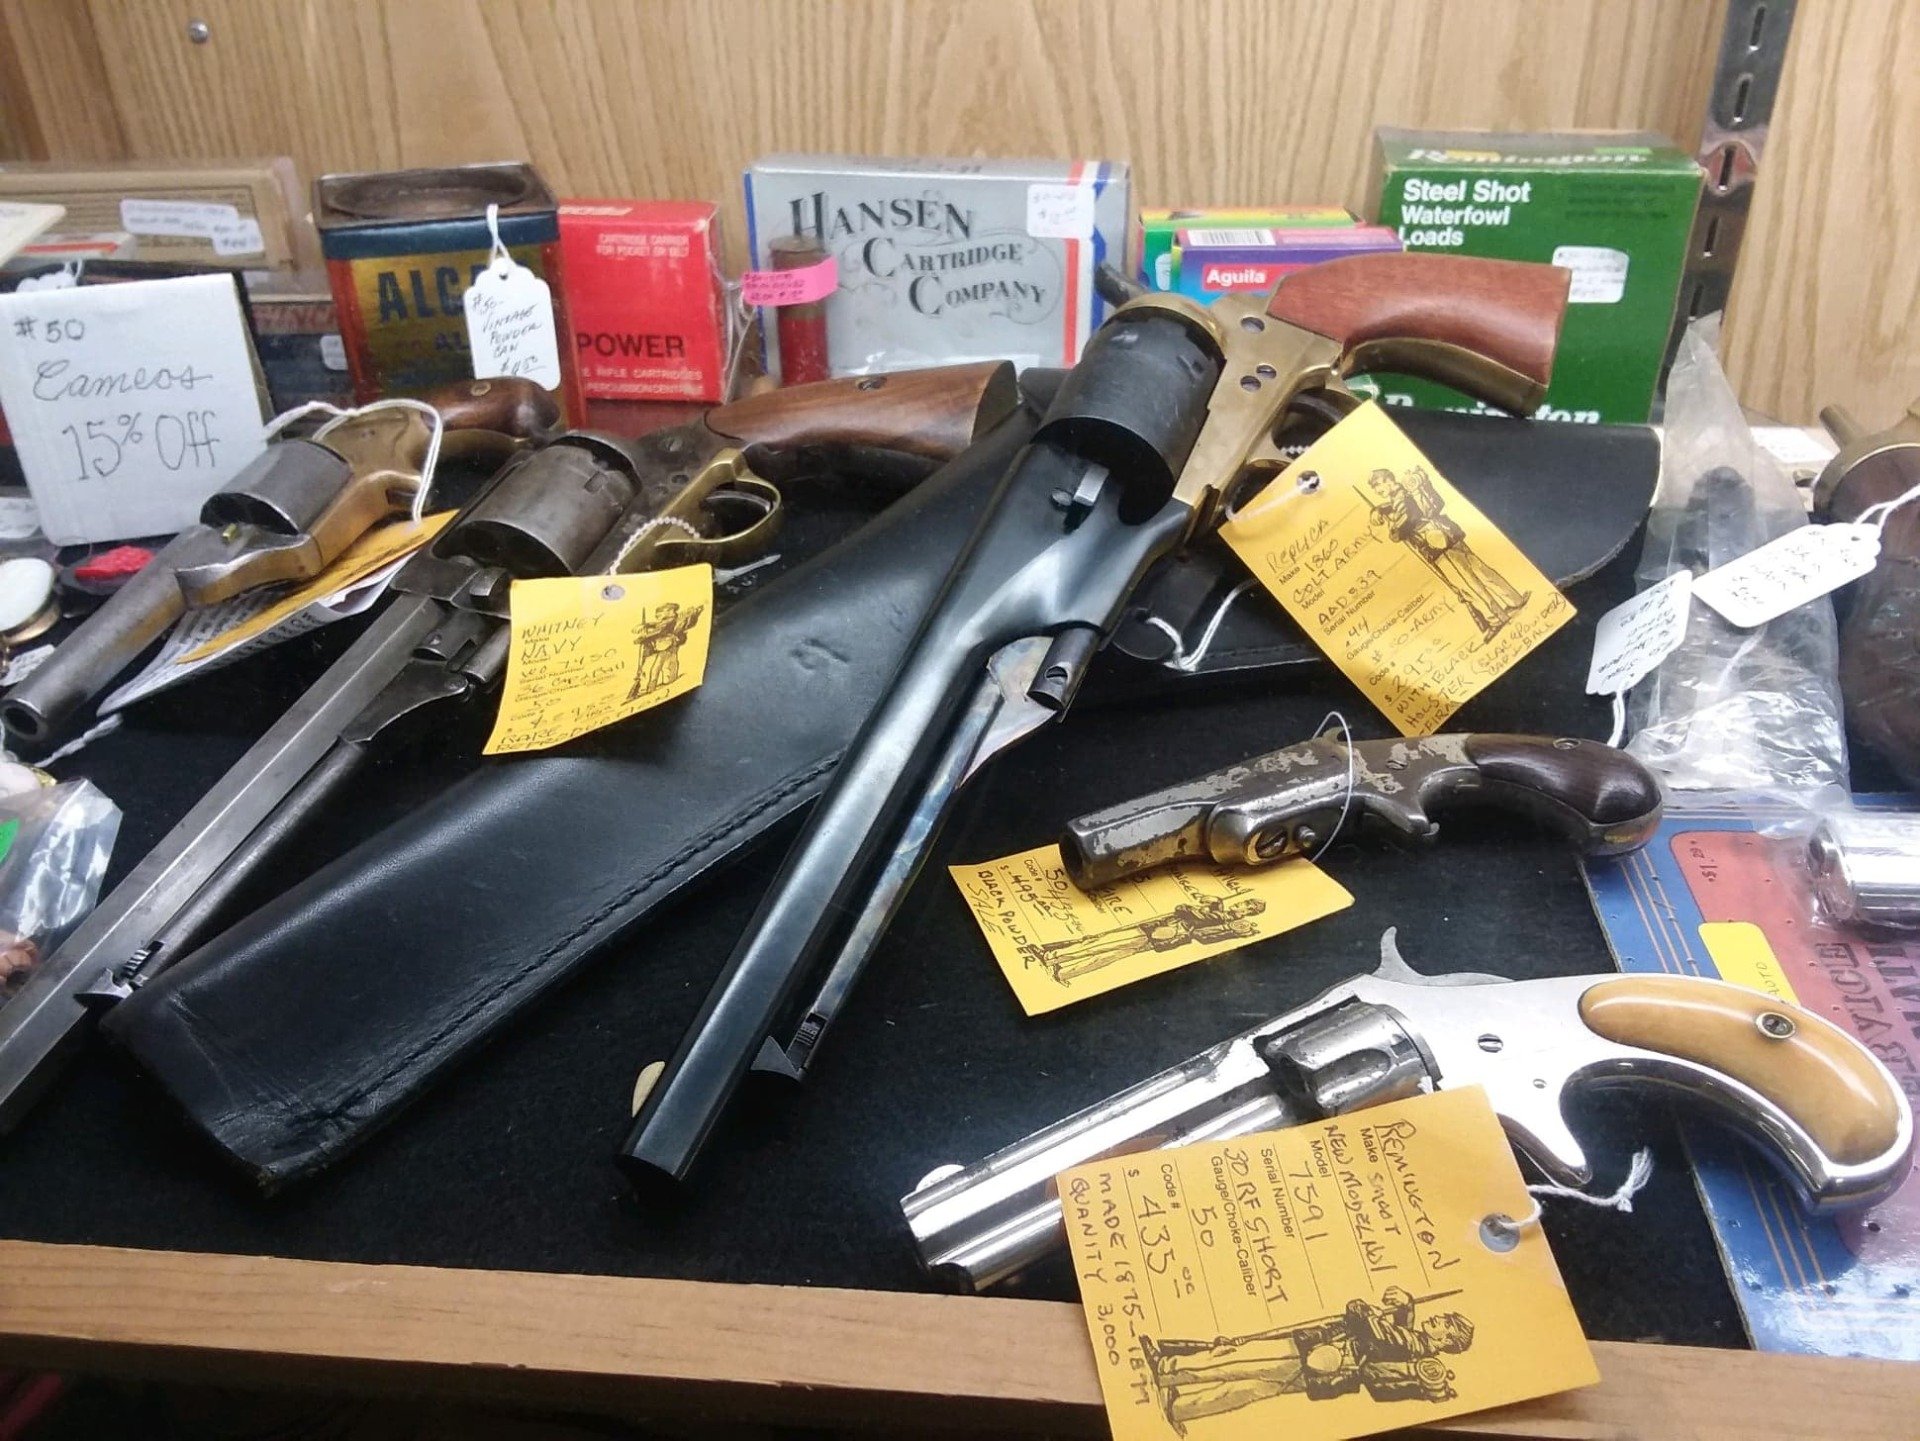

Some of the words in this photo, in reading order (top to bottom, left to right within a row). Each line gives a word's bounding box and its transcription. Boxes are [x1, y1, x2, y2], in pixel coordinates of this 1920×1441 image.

[1403, 178, 1467, 202] Steel
[1473, 179, 1532, 203] Shot
[790, 190, 973, 240] HANSEN
[1401, 204, 1511, 226] Waterfowl
[1399, 226, 1464, 246] Loads
[862, 237, 1025, 278] CARTRIDGE
[1206, 268, 1267, 287] Aguila
[909, 276, 1046, 316] COMPANY
[576, 333, 686, 358] POWER
[33, 358, 213, 401] Cameos
[62, 412, 144, 481] 15%
[155, 410, 220, 471] Off
[1023, 858, 1039, 878] Code
[1046, 868, 1069, 891] 50
[967, 883, 1005, 935] SALE
[978, 871, 1005, 908] BLACK
[998, 910, 1036, 970] POWDER
[1309, 1138, 1332, 1179] Model
[1324, 1125, 1354, 1165] NEW
[1359, 1126, 1381, 1164] Make
[1127, 1167, 1141, 1178] $
[1160, 1162, 1179, 1200] Code
[1171, 1200, 1182, 1211] #
[1260, 1146, 1282, 1185] Serial
[1271, 1186, 1297, 1240] Number
[1094, 1173, 1127, 1249] MADE
[1236, 1182, 1261, 1209] RF
[1289, 1161, 1328, 1240] 7591
[1375, 1119, 1460, 1270] REMINGTON
[1070, 1178, 1108, 1282] QUANITY
[1191, 1206, 1218, 1247] 50
[1209, 1154, 1259, 1298] Gauge/Choke-Caliber
[1244, 1216, 1288, 1302] SHORT
